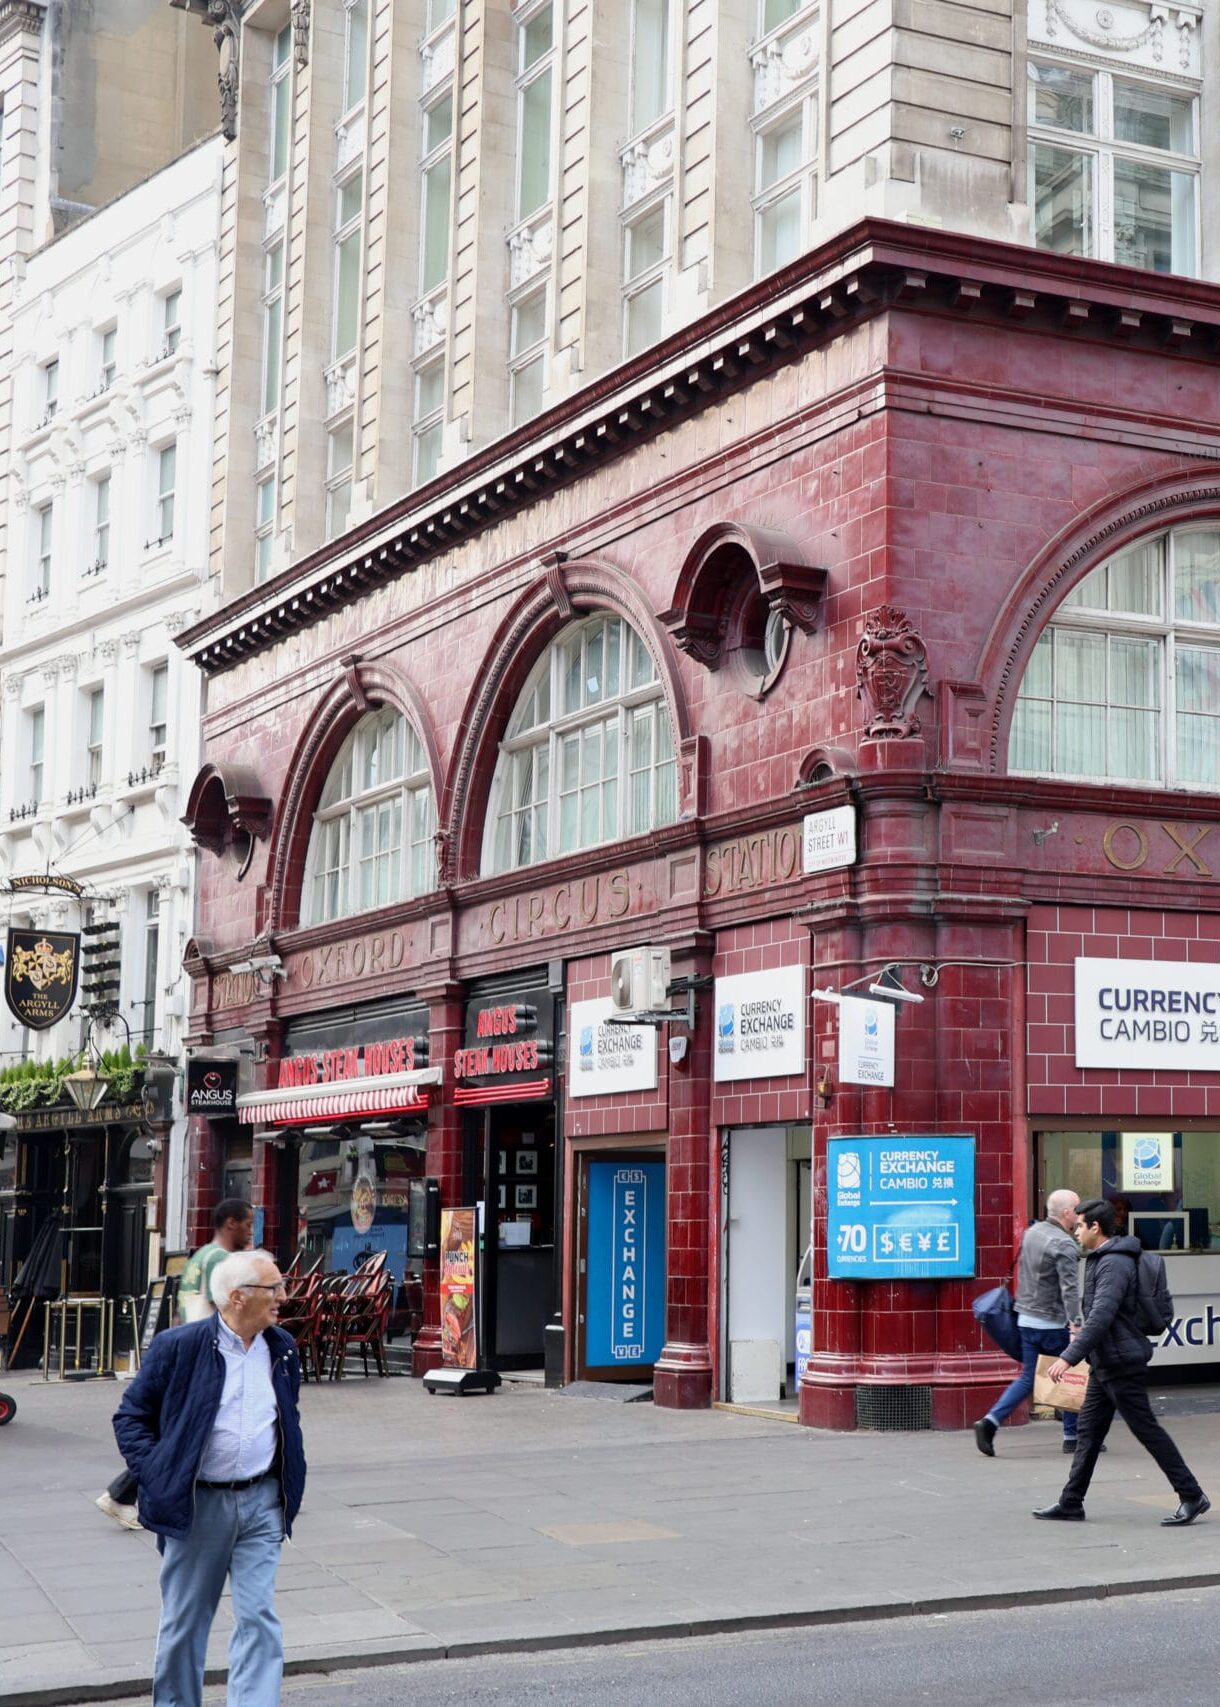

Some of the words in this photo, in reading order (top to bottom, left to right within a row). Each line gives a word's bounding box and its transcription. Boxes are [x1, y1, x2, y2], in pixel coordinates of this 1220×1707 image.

[808, 816, 836, 833] ARGYLL
[808, 833, 834, 852] STREET
[837, 830, 849, 845] W1
[704, 830, 804, 895] STATIO
[14, 876, 81, 894] NICHOLSON'S
[489, 870, 630, 944] CIRCUS
[301, 931, 404, 988] OXFORD
[18, 999, 60, 1009] ARGYLL
[24, 1009, 54, 1017] ARMS
[741, 998, 782, 1016] CURRENCY
[477, 1004, 516, 1037] ANGUS
[740, 1013, 794, 1035] EXCHANGE
[598, 1023, 631, 1037] CURRENCY
[1100, 1018, 1191, 1043] CAMBIO
[598, 1034, 642, 1054] EXCHANGE
[741, 1036, 768, 1051] CAMBIO
[279, 1055, 318, 1088] ANGUS
[322, 1047, 359, 1082] STEAK
[363, 1036, 415, 1076] HOUSES
[454, 1047, 488, 1079] STEAK
[492, 1040, 539, 1073] HOUSES
[858, 1061, 879, 1071] CURRENCY
[858, 1069, 884, 1081] EXCHANGE
[191, 1089, 232, 1100] ANGUS
[880, 1151, 939, 1161] CURRENCY
[880, 1161, 955, 1174] EXCHANGE
[880, 1178, 928, 1190] CAMBIO
[837, 1191, 861, 1199] Global
[622, 1191, 636, 1338] EXCHANGE
